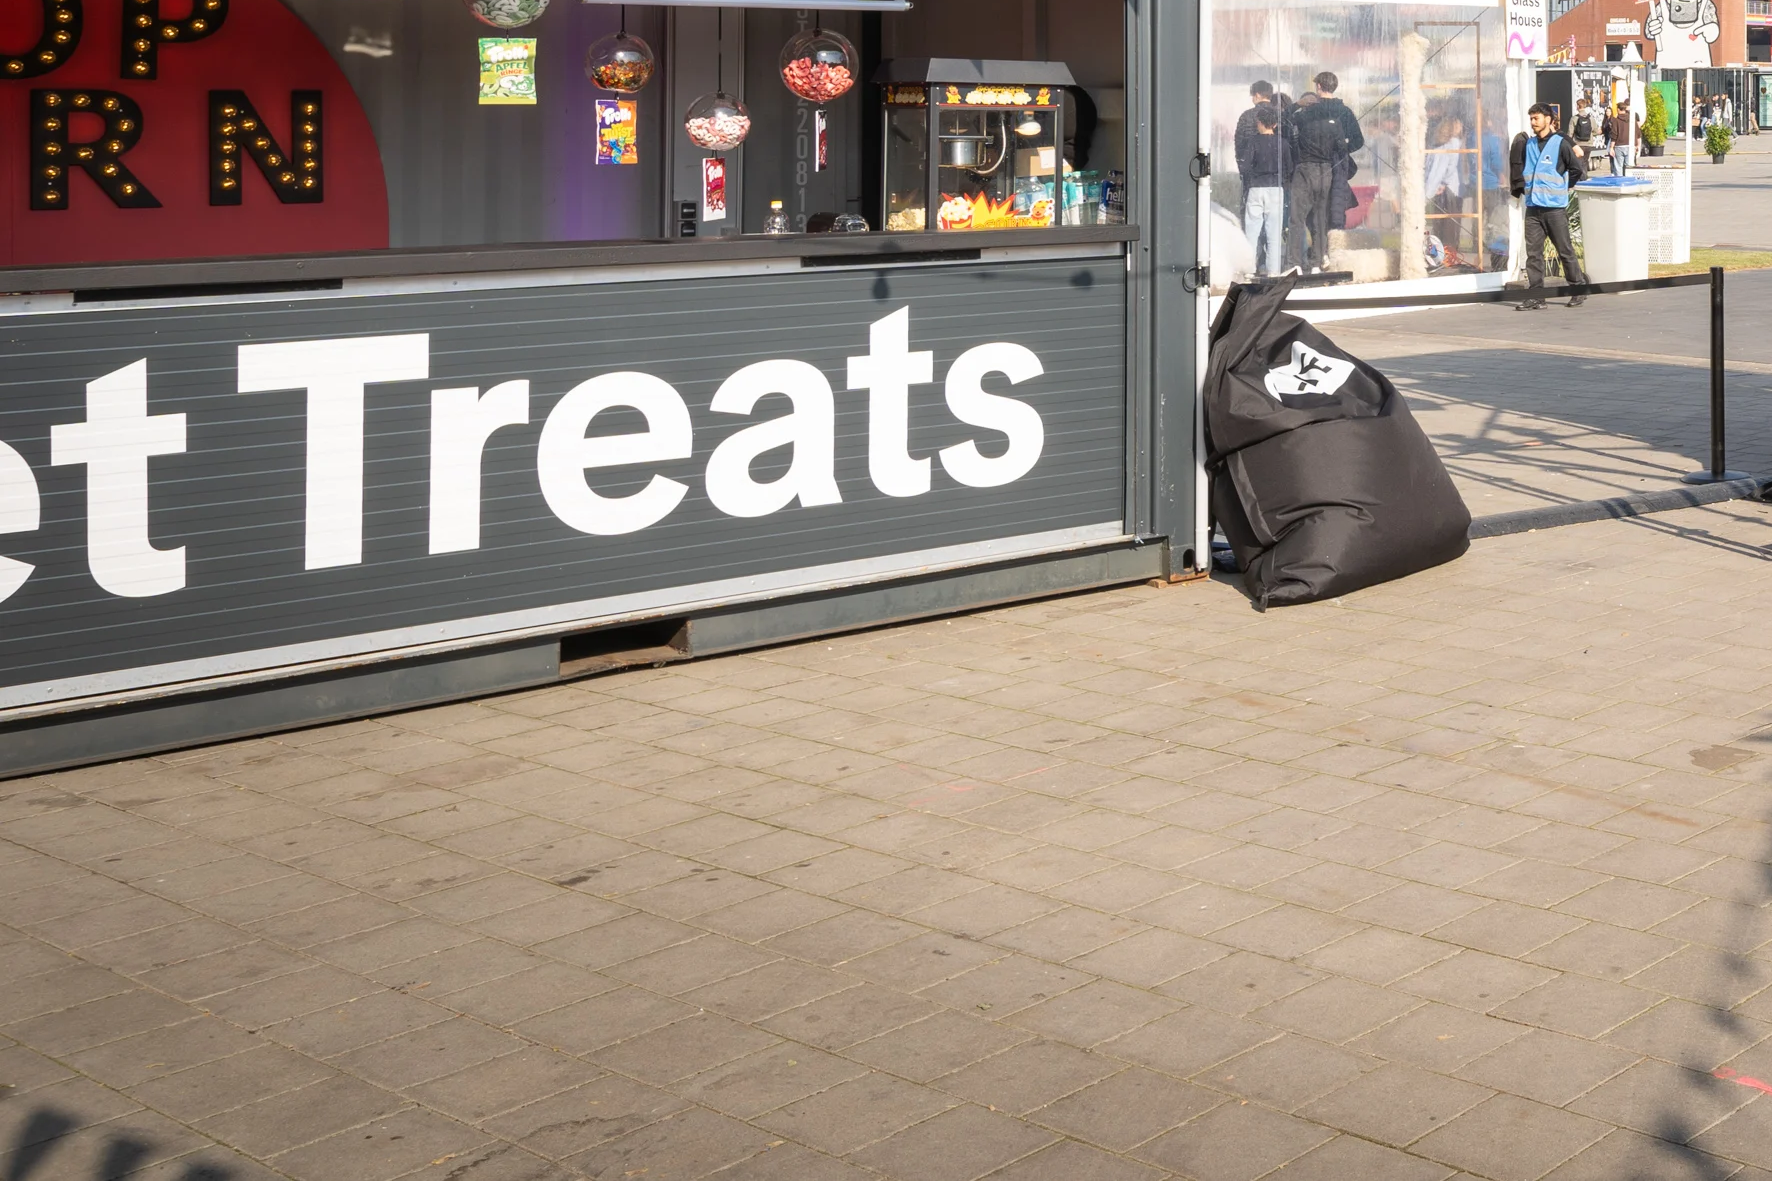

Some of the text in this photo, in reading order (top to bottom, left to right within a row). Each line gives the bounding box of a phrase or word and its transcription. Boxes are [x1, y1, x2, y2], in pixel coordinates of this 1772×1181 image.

[1510, 11, 1543, 28] House
[487, 45, 529, 64] Trolli
[496, 61, 529, 73] APFEL
[602, 107, 632, 125] Trolli
[236, 305, 1046, 572] Treats
